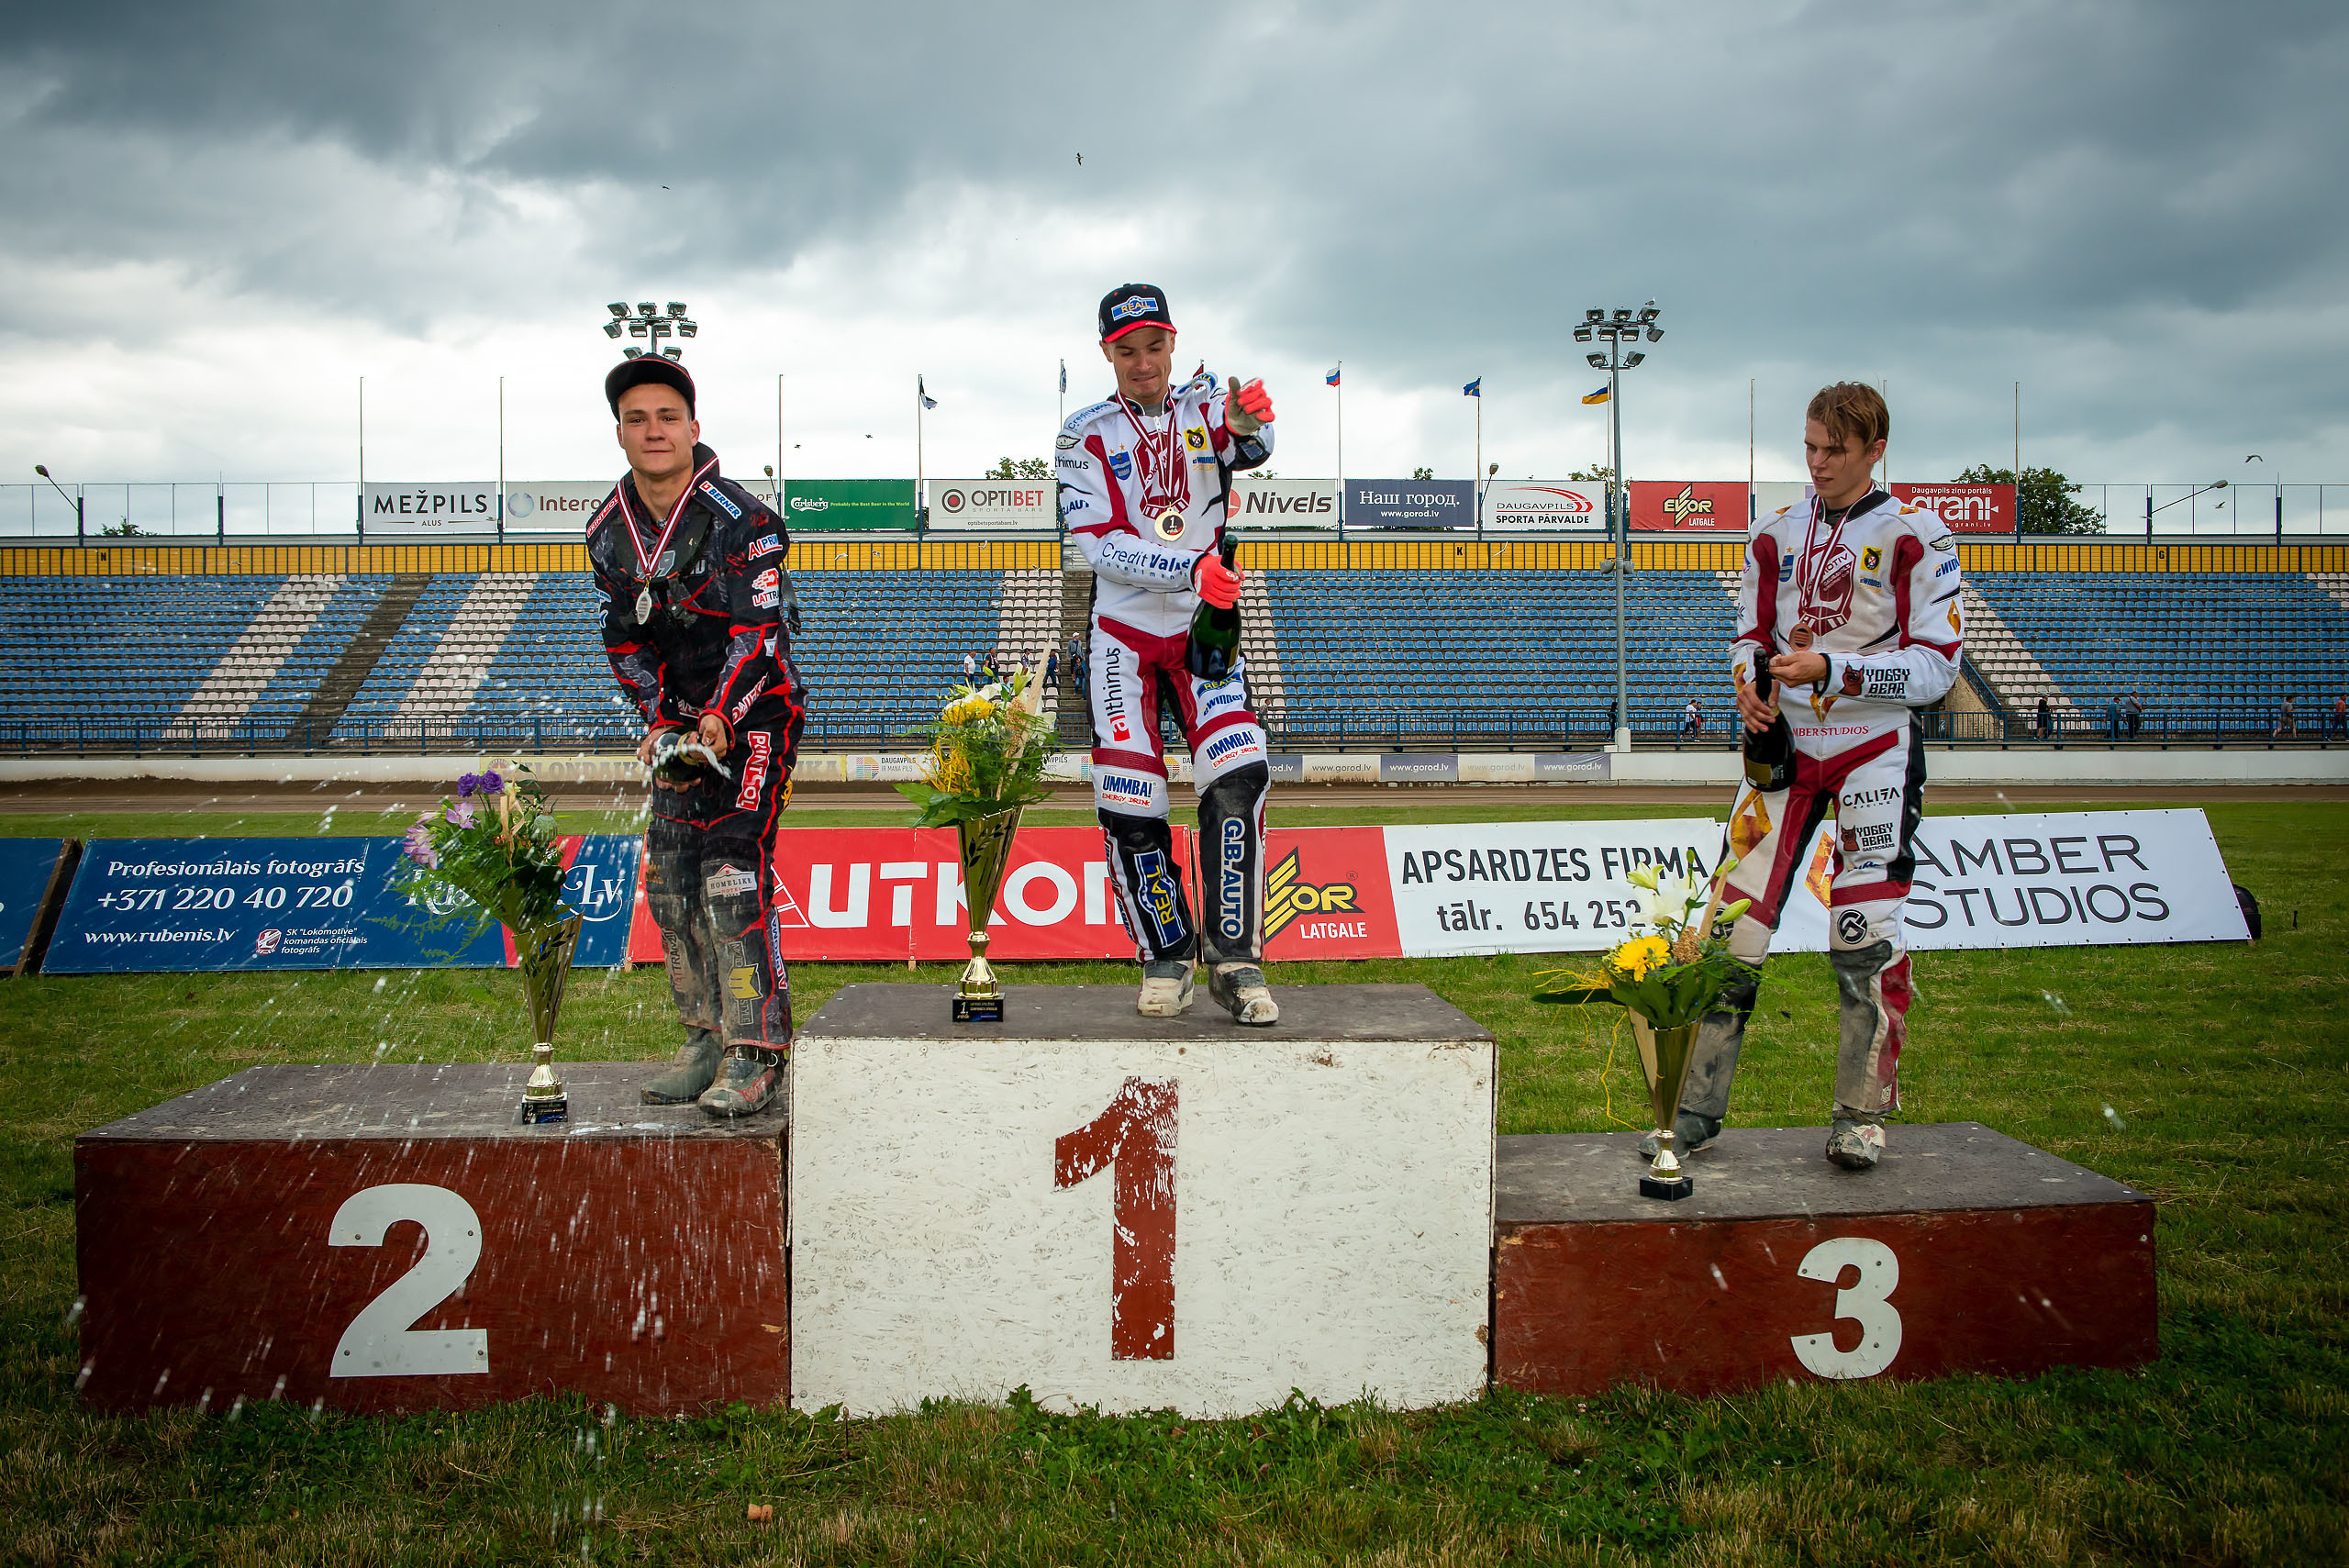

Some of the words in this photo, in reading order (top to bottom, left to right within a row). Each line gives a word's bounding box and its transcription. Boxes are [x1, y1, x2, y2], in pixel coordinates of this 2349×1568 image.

[1121, 301, 1150, 313] REALL
[972, 490, 1043, 506] OPTIBET
[1911, 487, 1949, 495] Daugavpils
[373, 490, 488, 514] MEŽPILS
[708, 487, 740, 517] BERNER
[791, 496, 829, 511] Carlsberg
[1246, 491, 1332, 514] Nivels
[1359, 491, 1400, 506] Наш
[1405, 492, 1461, 508] город.
[1497, 502, 1574, 511] DAUGAVPILS
[1380, 509, 1440, 519] www.gorod.lv
[1496, 515, 1535, 524] SPORTA
[1539, 513, 1589, 524] PĀRVALDE
[1688, 517, 1715, 526] LATGALE
[101, 552, 106, 561] N
[1456, 546, 1463, 556] K
[2158, 550, 2165, 560] G
[1865, 669, 1910, 682] YOGGY
[1869, 683, 1905, 694] BEAR
[1820, 725, 1869, 737] STUDIOS
[1207, 730, 1255, 761] UMMBA!
[1213, 751, 1238, 767] ENERGY
[1312, 763, 1371, 773] www.gorod.lv
[1389, 762, 1449, 773] www.gorod.lv
[1468, 763, 1525, 773] www.gorod.lv
[1543, 762, 1602, 773] www.gorod.lv
[1102, 775, 1152, 797] UMMBA!
[1102, 793, 1126, 803] ENERGY
[1128, 796, 1151, 806] DRINK
[1856, 823, 1893, 836] YOGGY
[1862, 834, 1892, 846] BEAR
[1912, 834, 2149, 876] AMBER
[107, 861, 262, 877] Profesionālais
[267, 859, 365, 878] fotogrāfs
[1402, 848, 1591, 884] APSARDZES
[1223, 819, 1242, 937] G.B.AUTO
[97, 889, 166, 911] +371
[173, 888, 234, 910] 220
[242, 887, 286, 909] 40
[296, 886, 353, 908] 720
[1904, 881, 2170, 929] STUDIOS
[1437, 899, 1502, 932] tālr.
[1524, 901, 1579, 931] 654
[84, 929, 236, 944] www.rubenis.lv
[1300, 922, 1368, 940] LATGALE
[284, 937, 328, 945] komandas
[330, 936, 368, 945] oficiālais
[281, 946, 320, 955] fotogrāfs
[1055, 1075, 1178, 1362] 1
[327, 1184, 489, 1377] 2
[1791, 1238, 1902, 1379] 3
